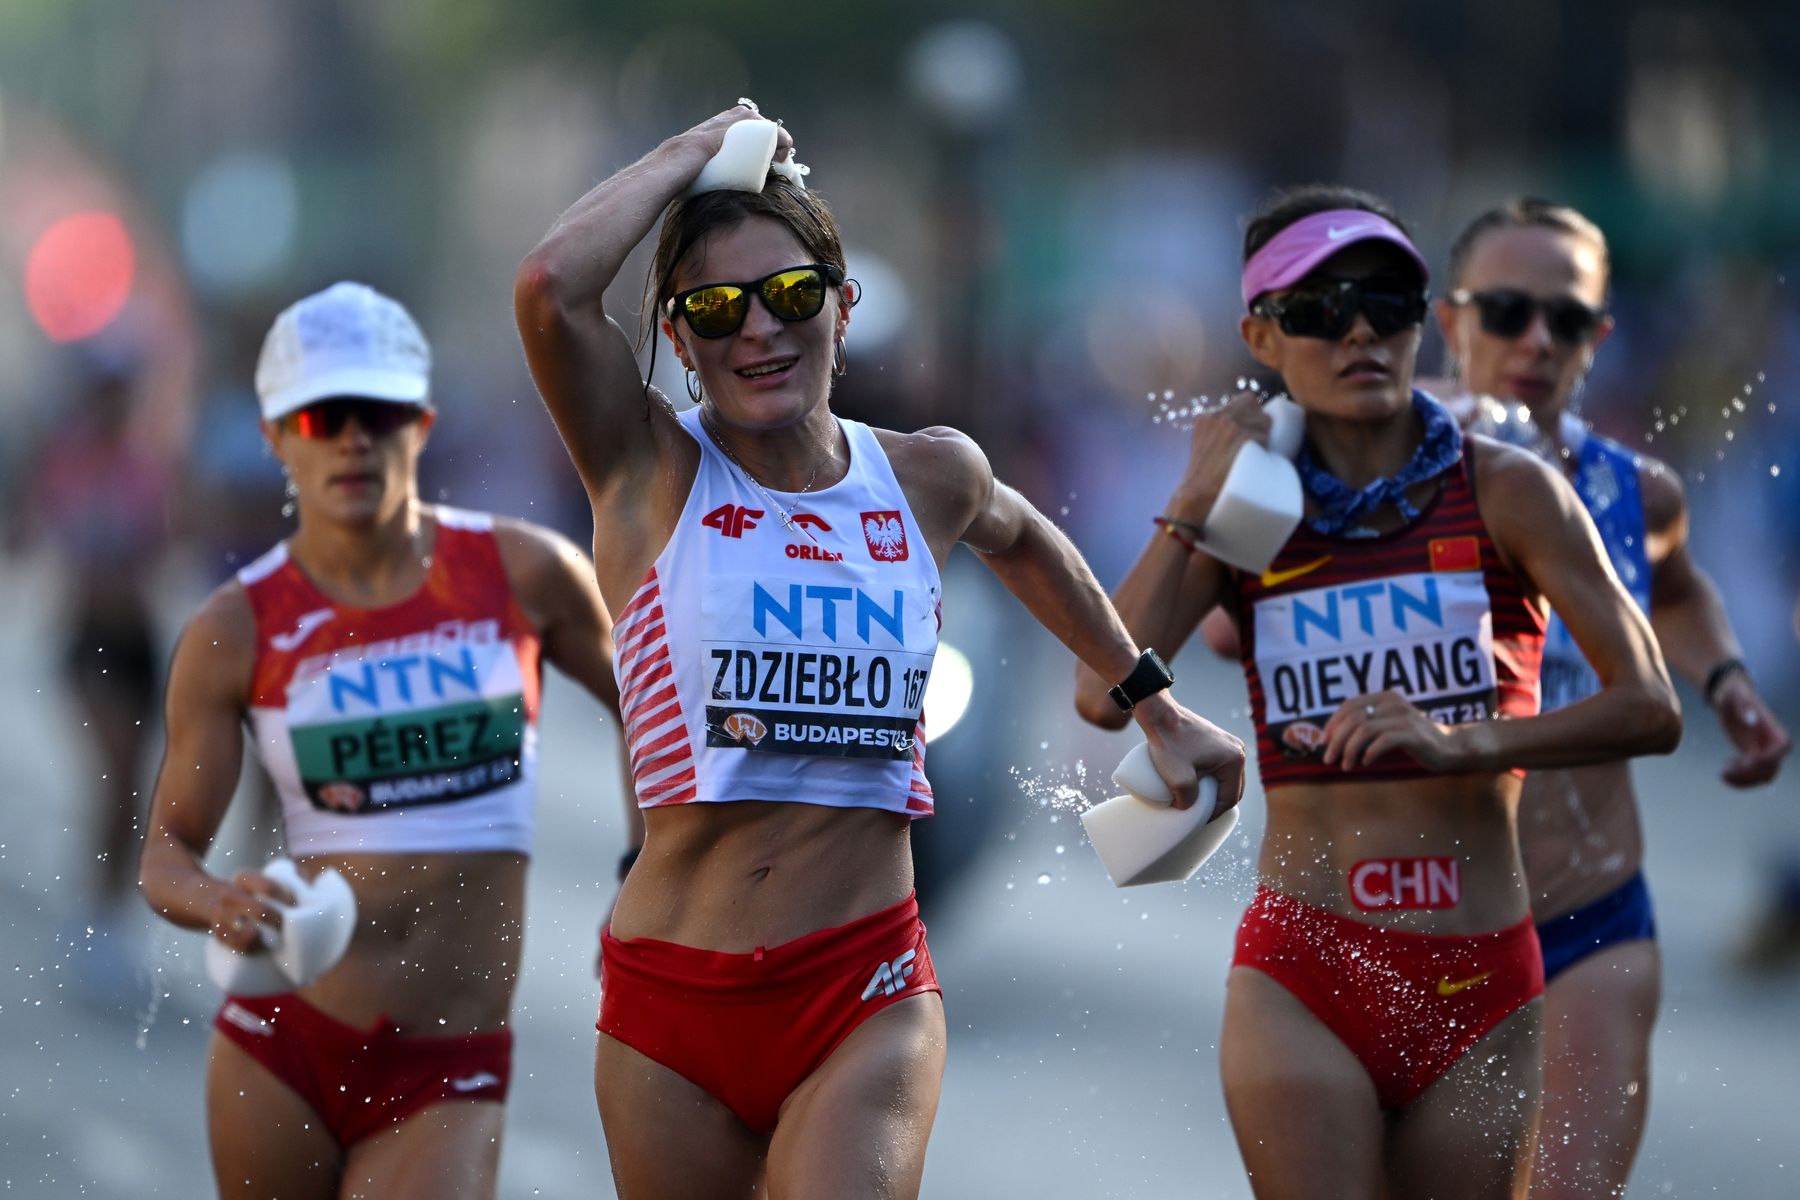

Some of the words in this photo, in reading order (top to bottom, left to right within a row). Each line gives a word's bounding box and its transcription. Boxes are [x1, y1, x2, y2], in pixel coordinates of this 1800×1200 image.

[753, 581, 904, 647] NTN
[1291, 577, 1443, 646] NTN
[328, 646, 479, 712] NTN
[711, 649, 891, 709] ZDZIEBŁO
[903, 667, 927, 709] 167
[1273, 637, 1481, 718] QIEYANG
[329, 711, 492, 775] PÉREZ
[1353, 860, 1459, 908] CHN
